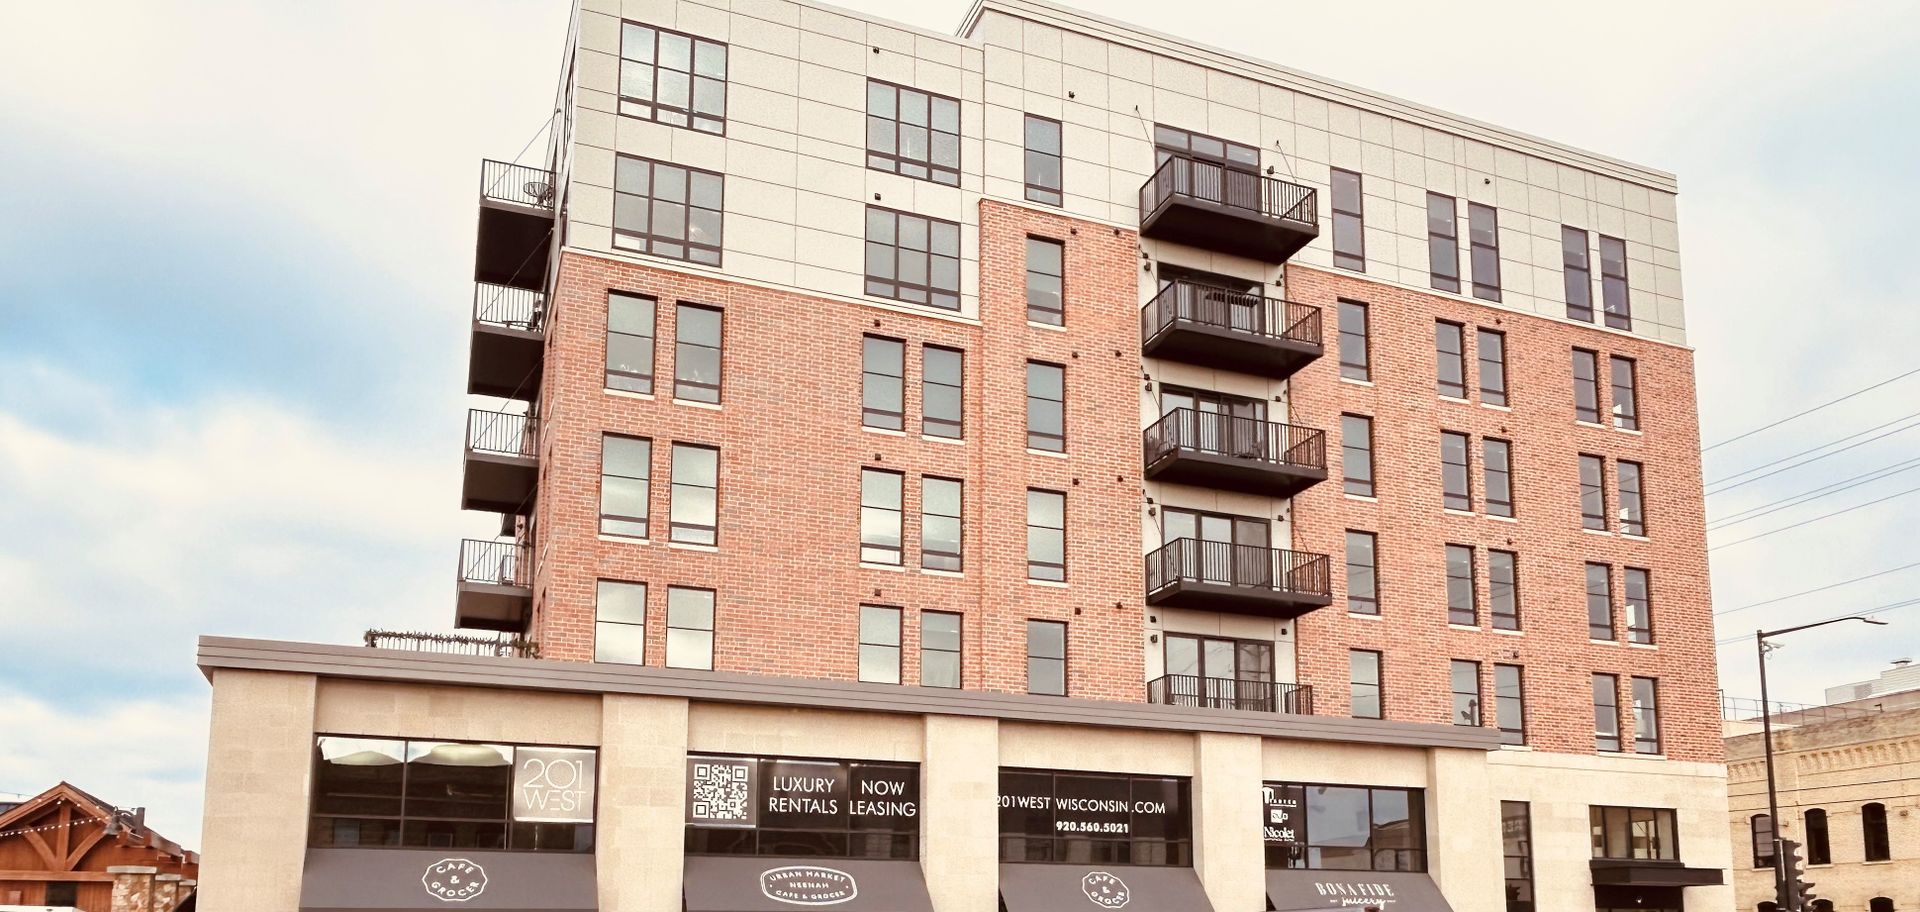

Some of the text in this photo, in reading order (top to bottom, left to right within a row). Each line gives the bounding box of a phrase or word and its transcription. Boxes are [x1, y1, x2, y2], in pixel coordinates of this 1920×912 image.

[523, 758, 583, 789] 201
[773, 776, 835, 793] LUXURY
[861, 780, 905, 796] NOW
[523, 788, 587, 812] WEST
[769, 797, 838, 815] RENTALS
[1056, 798, 1129, 813] WISCONSIN
[849, 800, 916, 817] LEASING
[1055, 821, 1129, 834] 920.560.5021
[436, 863, 474, 874] CAFE
[769, 871, 846, 882] URBAN MARKET
[431, 881, 480, 897] GROCER
[775, 890, 799, 899] CAFE
[810, 890, 846, 900] GROCER
[1341, 896, 1386, 911] juicery
